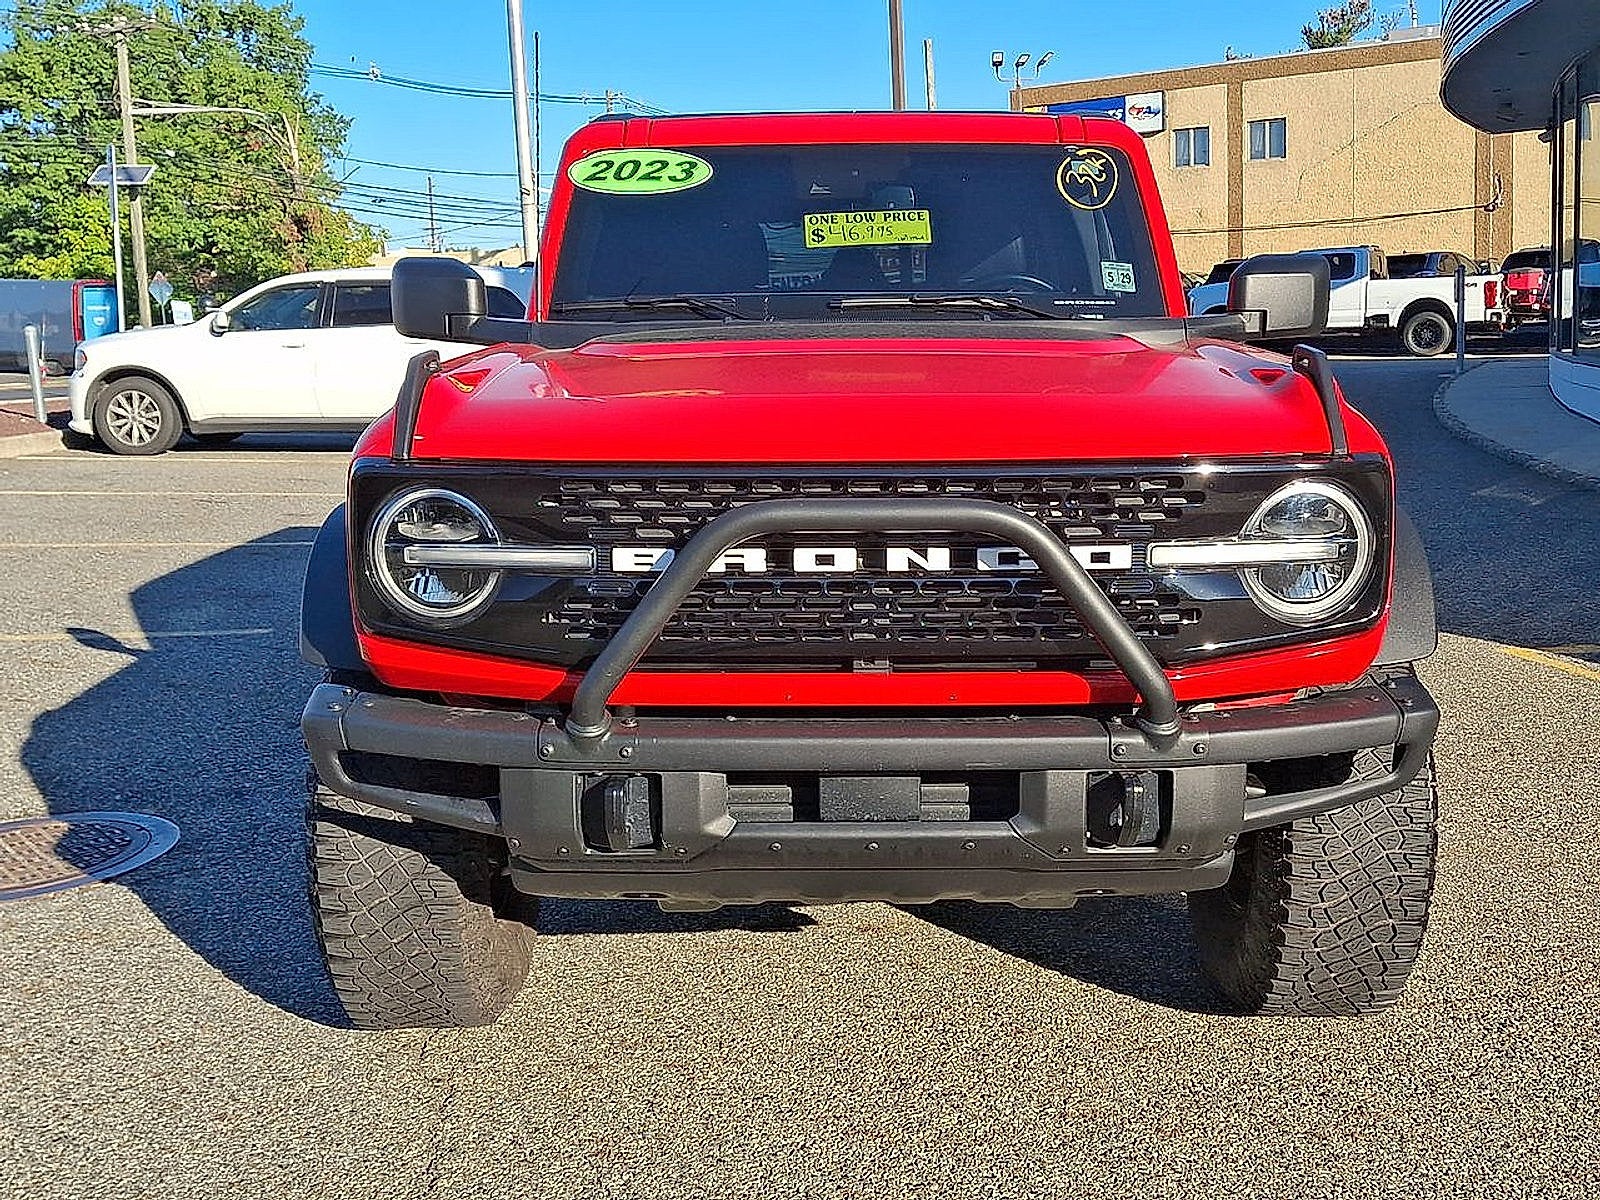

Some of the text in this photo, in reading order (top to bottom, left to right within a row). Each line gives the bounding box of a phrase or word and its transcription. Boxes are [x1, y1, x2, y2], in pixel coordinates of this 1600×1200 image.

[582, 159, 698, 182] 2023
[808, 211, 925, 225] ONE LOW PRICE
[1107, 271, 1131, 284] 5 29
[612, 546, 1132, 573] BRONCO
